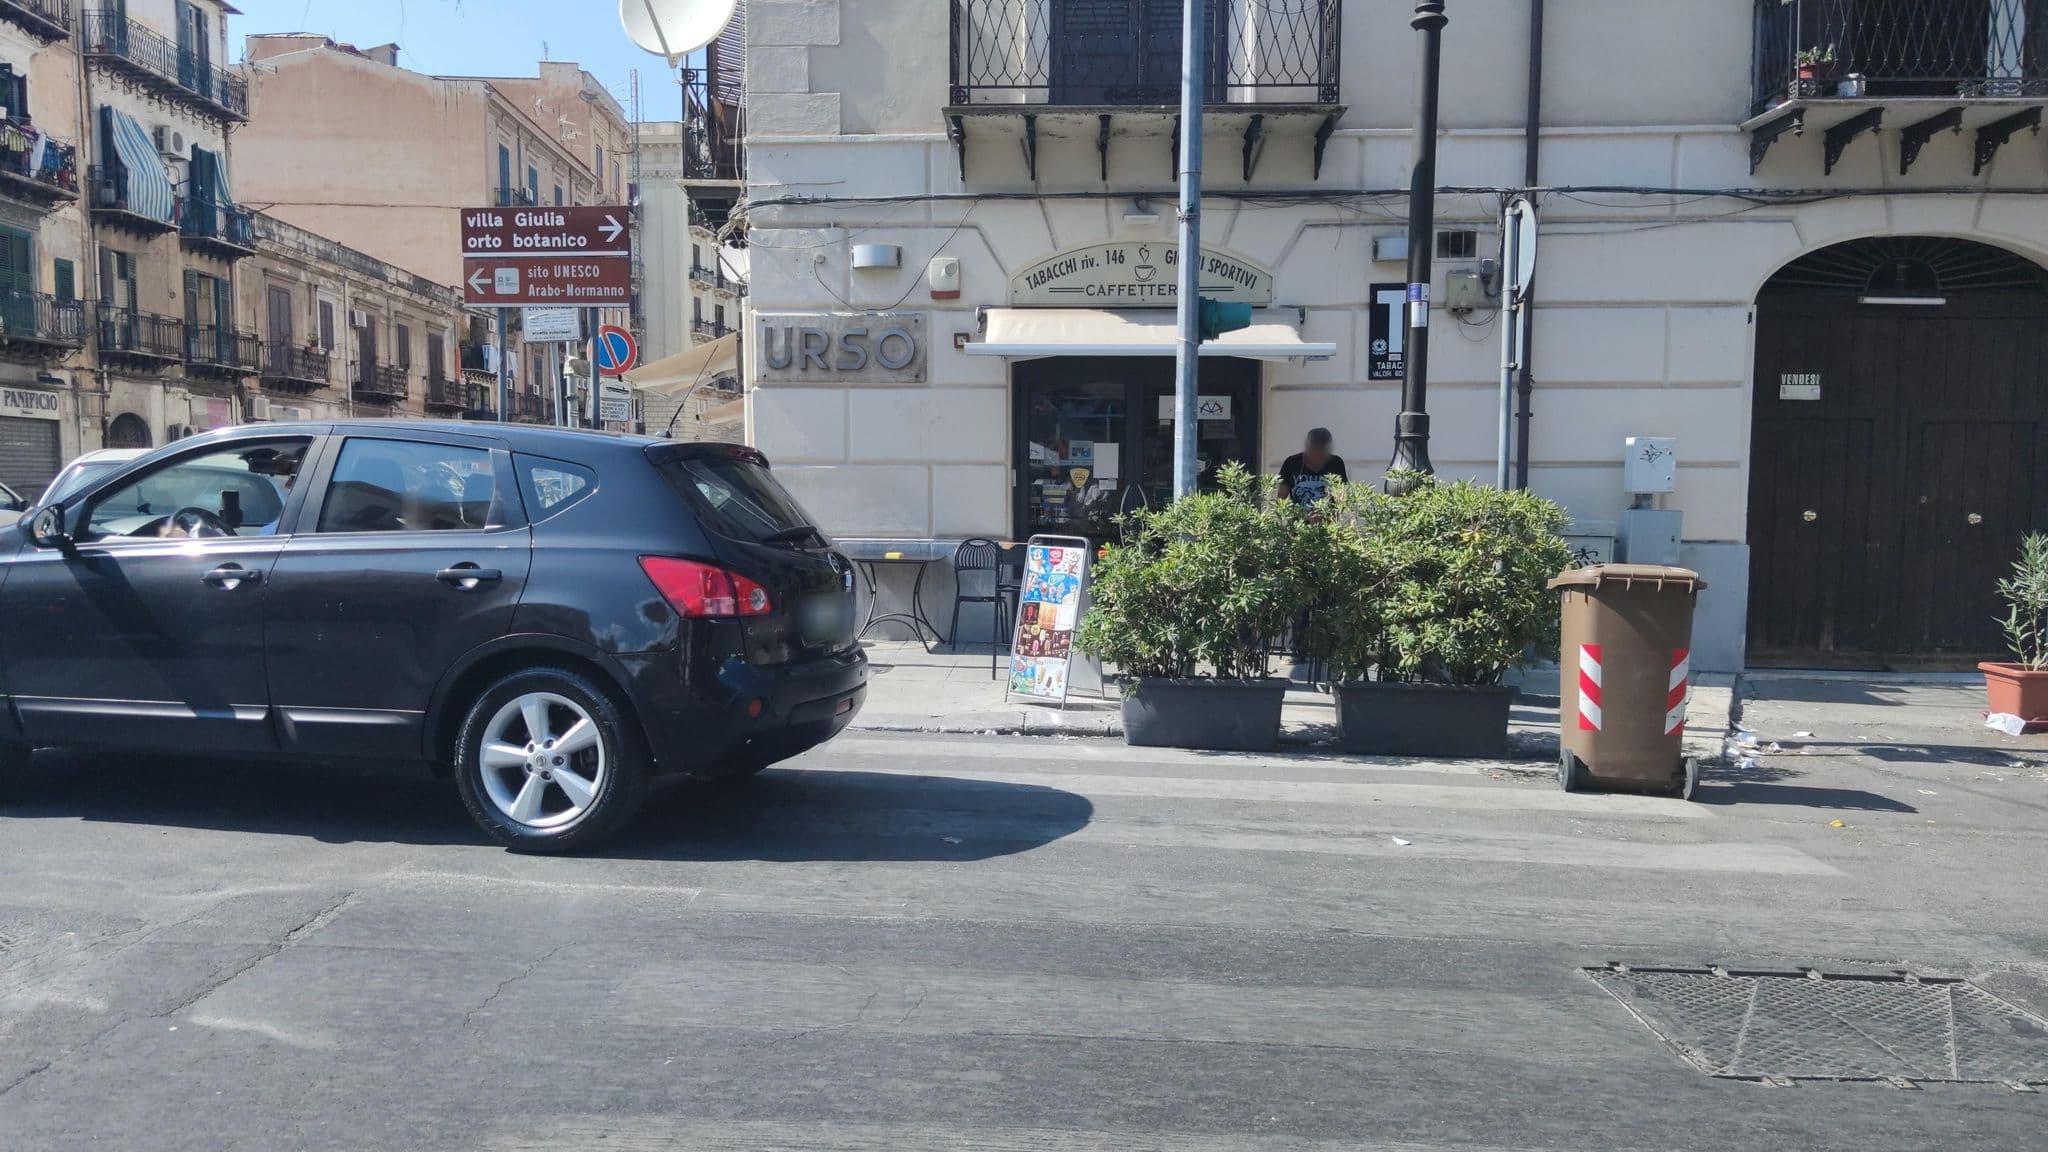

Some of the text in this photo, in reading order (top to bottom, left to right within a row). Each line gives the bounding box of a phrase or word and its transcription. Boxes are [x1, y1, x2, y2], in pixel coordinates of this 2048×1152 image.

[467, 212, 565, 227] villa Giulia
[467, 233, 587, 248] orto botanico
[527, 265, 600, 278] sito UNESCO
[1025, 257, 1078, 291] TABACCHI
[1081, 254, 1100, 271] riv.
[1106, 249, 1125, 265] 146
[1208, 258, 1258, 290] SPORTIVI
[528, 284, 625, 297] Arabo-Normanno
[1086, 284, 1178, 297] CAFFETTER
[764, 326, 916, 370] URSO
[3, 390, 58, 411] PANIFICIO
